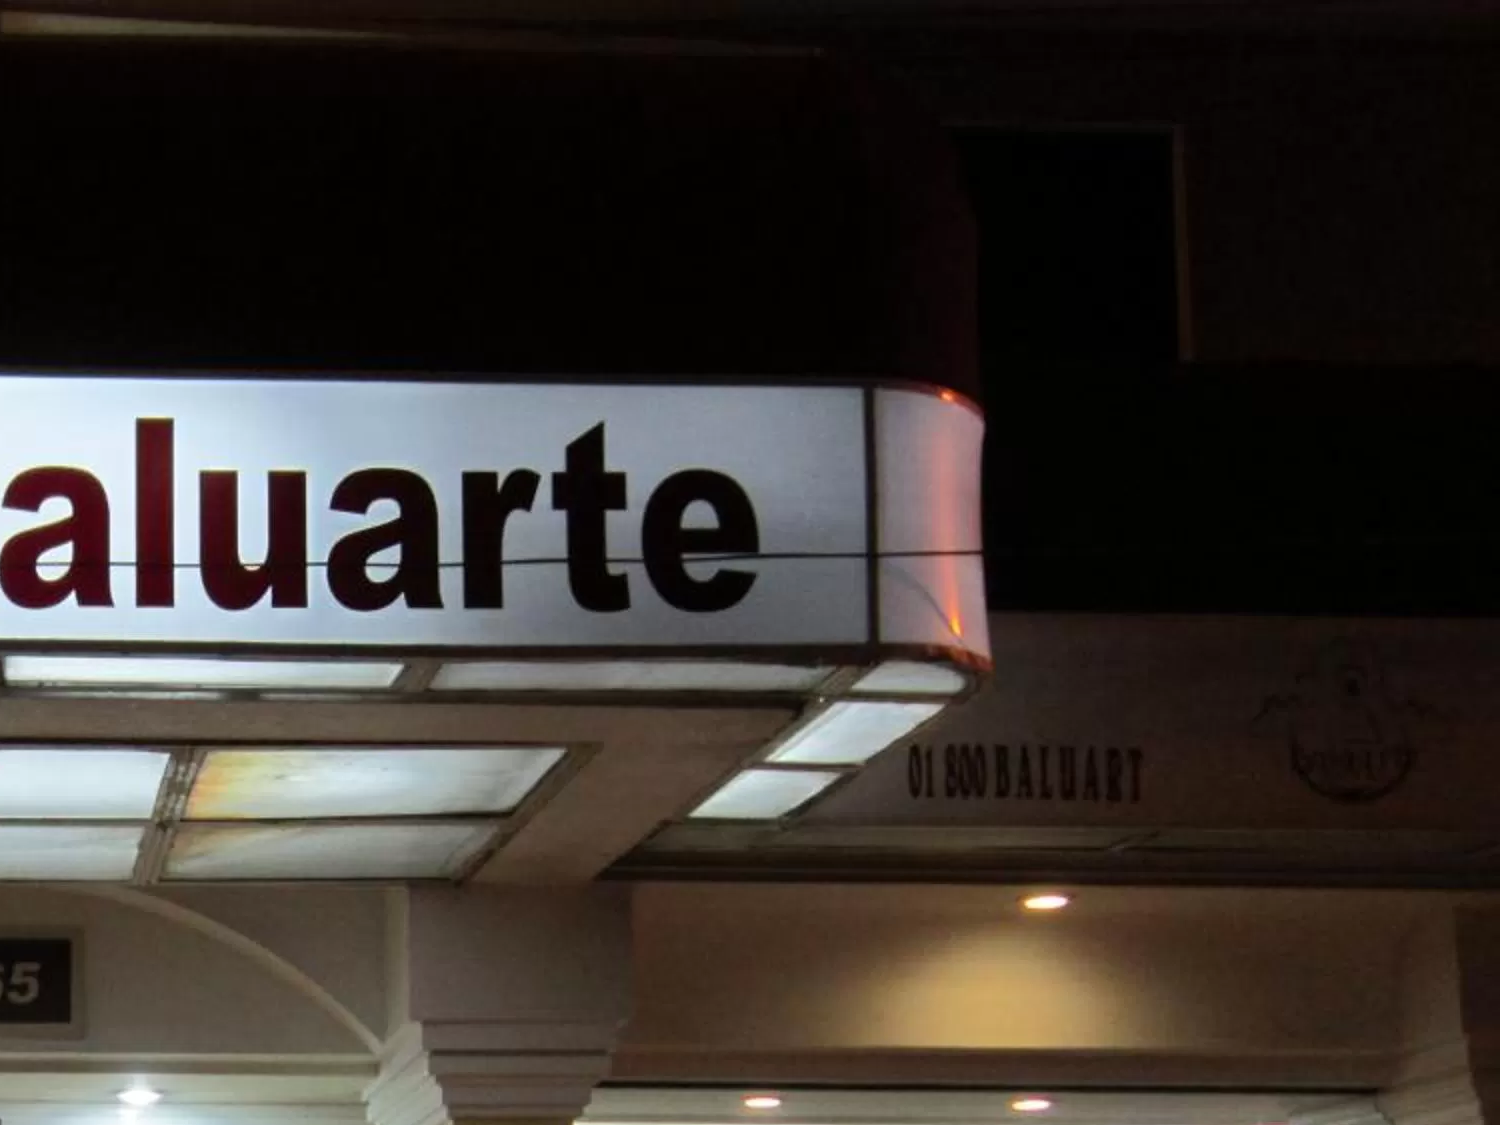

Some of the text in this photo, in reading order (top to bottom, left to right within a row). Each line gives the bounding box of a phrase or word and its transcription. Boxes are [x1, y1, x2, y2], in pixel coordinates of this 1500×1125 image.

[908, 743, 1144, 804] 01 800 BALUART
